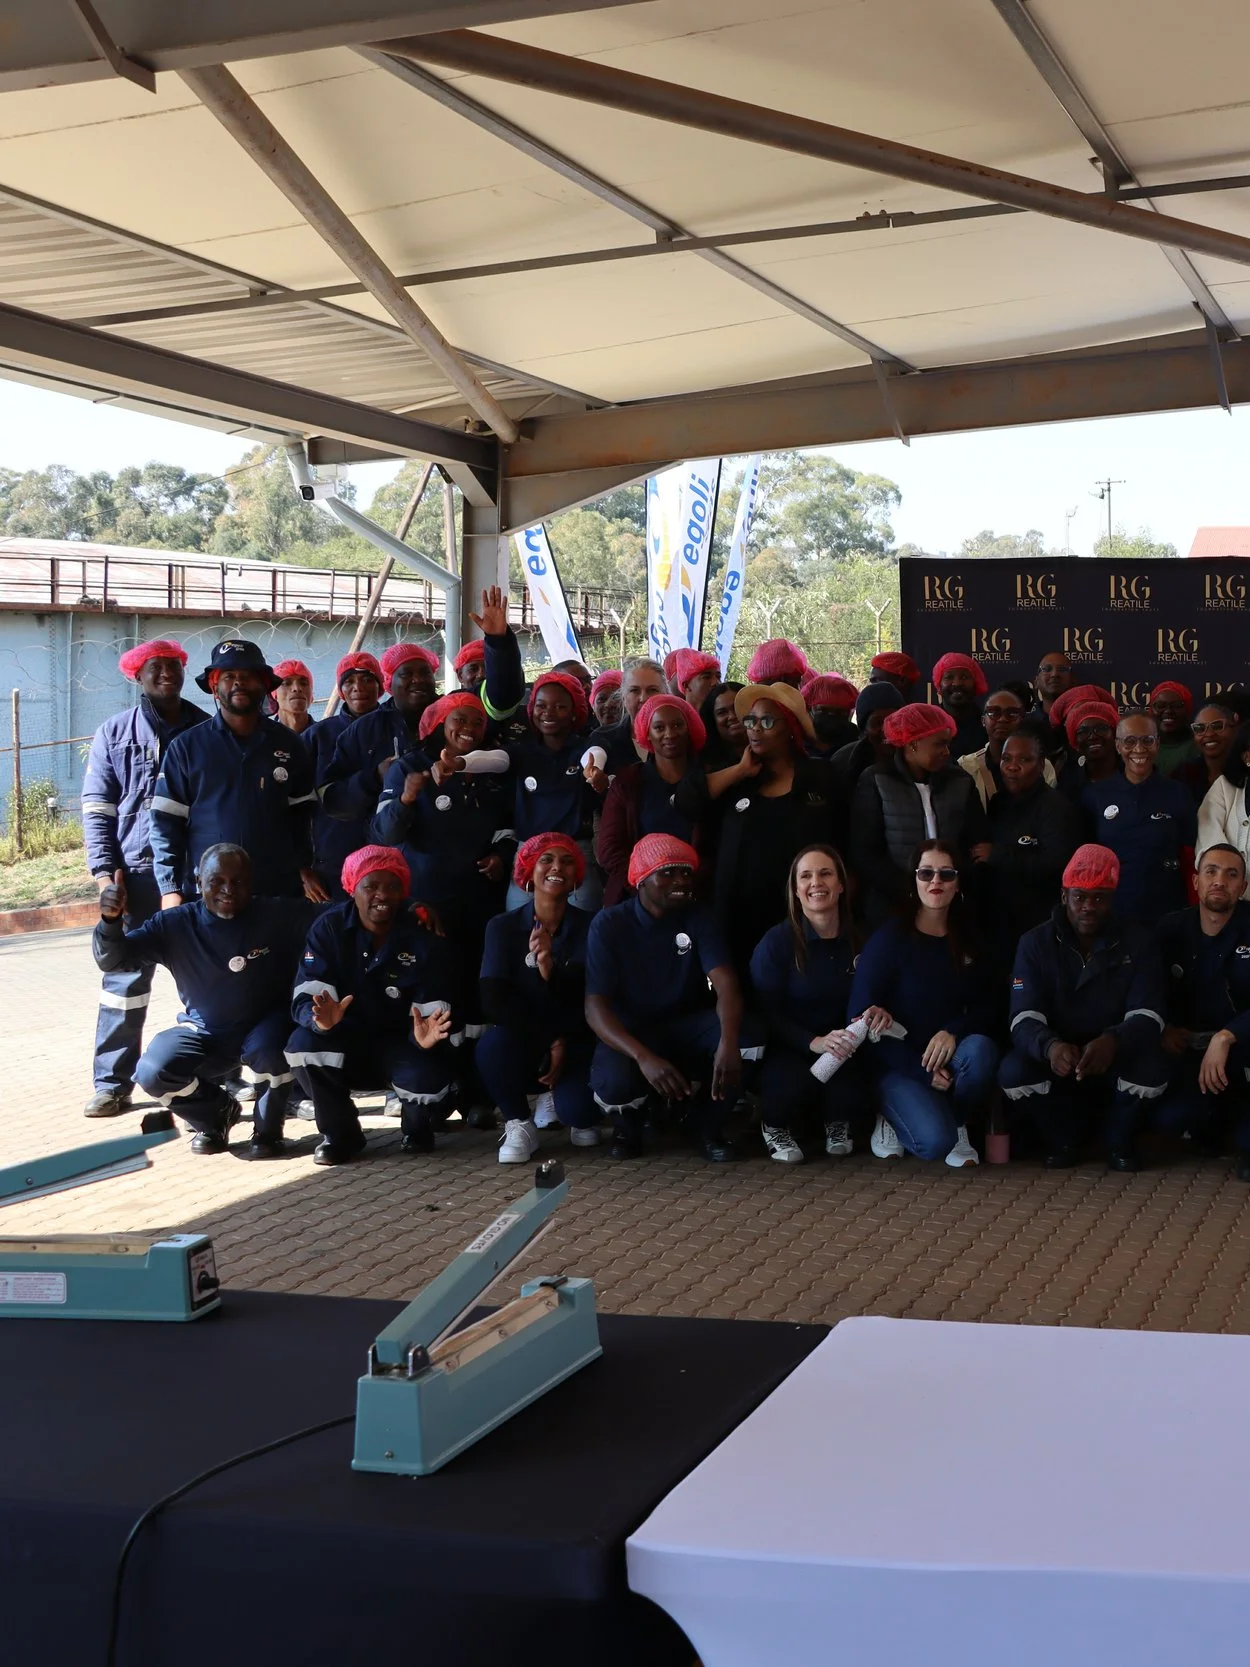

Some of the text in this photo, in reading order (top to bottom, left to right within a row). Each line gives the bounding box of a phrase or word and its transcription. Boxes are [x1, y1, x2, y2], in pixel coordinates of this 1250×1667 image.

[682, 473, 710, 566] egoli
[925, 576, 963, 599] RG
[1017, 574, 1056, 598] RG
[1111, 576, 1150, 599] RG
[1206, 575, 1245, 598] RG
[925, 600, 963, 609] REATILE
[1016, 599, 1056, 607] REATILE
[1110, 600, 1150, 608] REATILE
[1205, 600, 1245, 608] REATILE
[971, 629, 1011, 652] RG
[1064, 628, 1103, 651] RG
[1158, 629, 1197, 652] RG
[1157, 654, 1198, 662] REATILE
